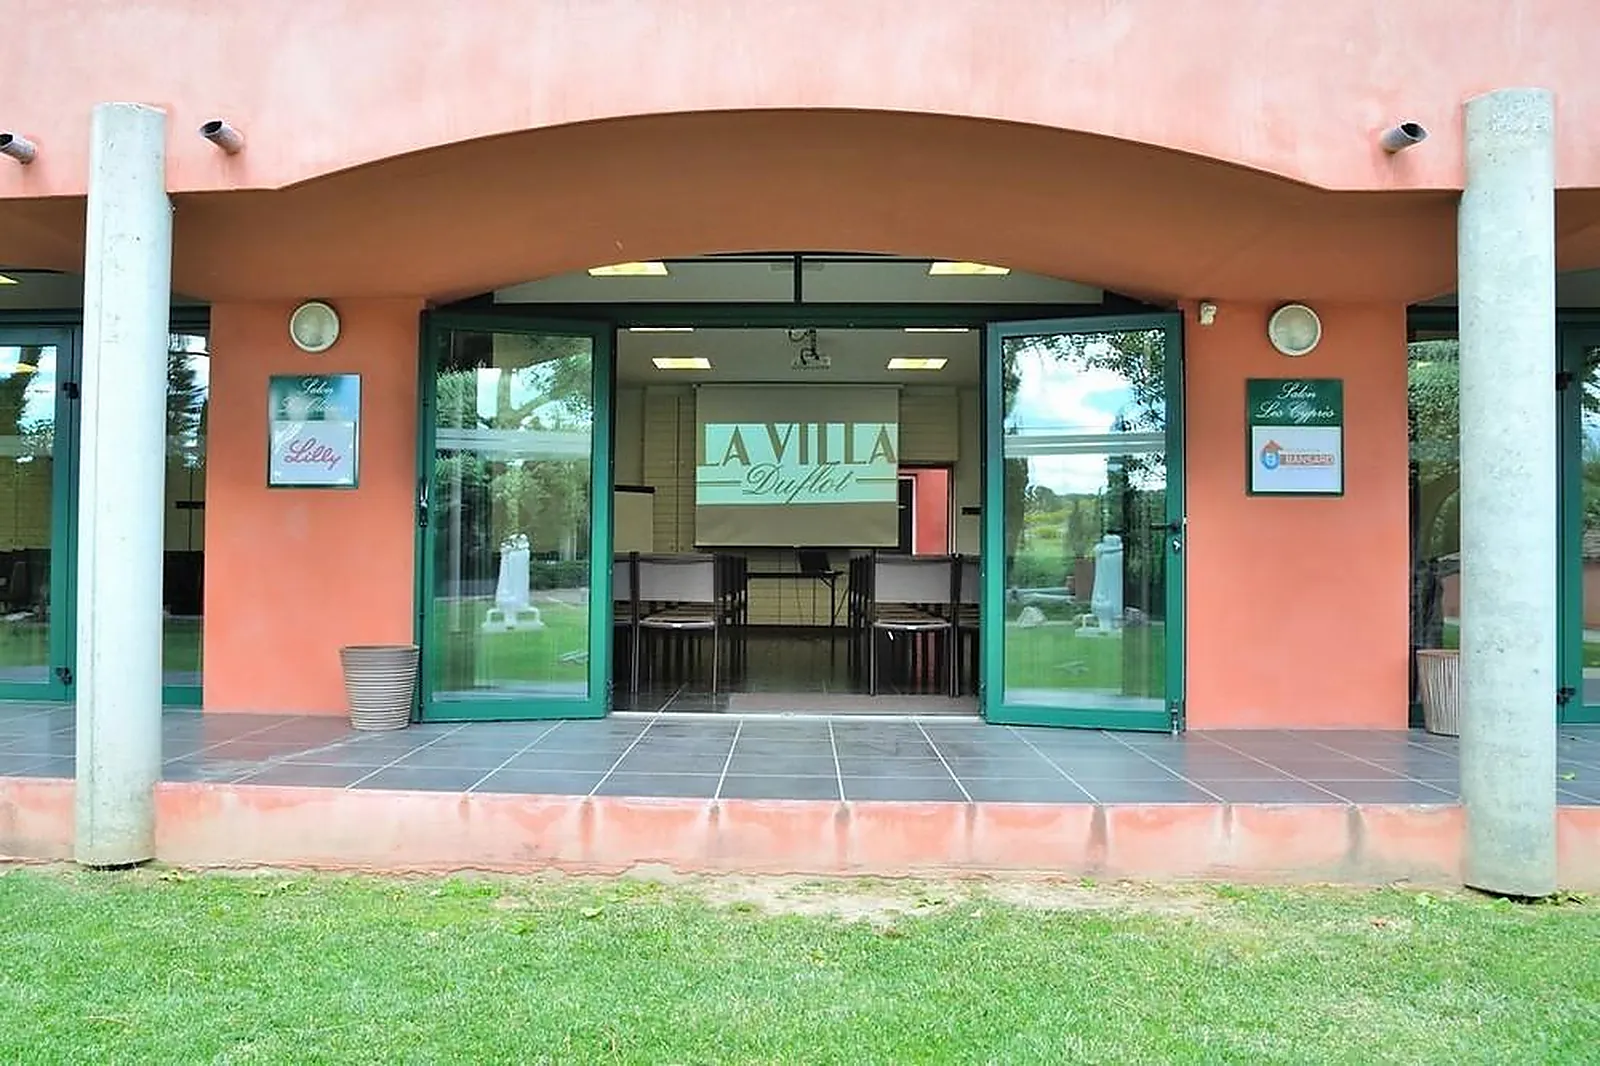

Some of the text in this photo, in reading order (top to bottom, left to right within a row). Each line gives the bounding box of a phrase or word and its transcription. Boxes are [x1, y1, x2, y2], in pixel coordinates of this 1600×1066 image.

[1277, 382, 1316, 399] Salon
[1254, 400, 1283, 418] Les
[284, 437, 342, 470] Lilly
[696, 422, 898, 467] LA VILLA
[743, 462, 854, 504] Duflot
